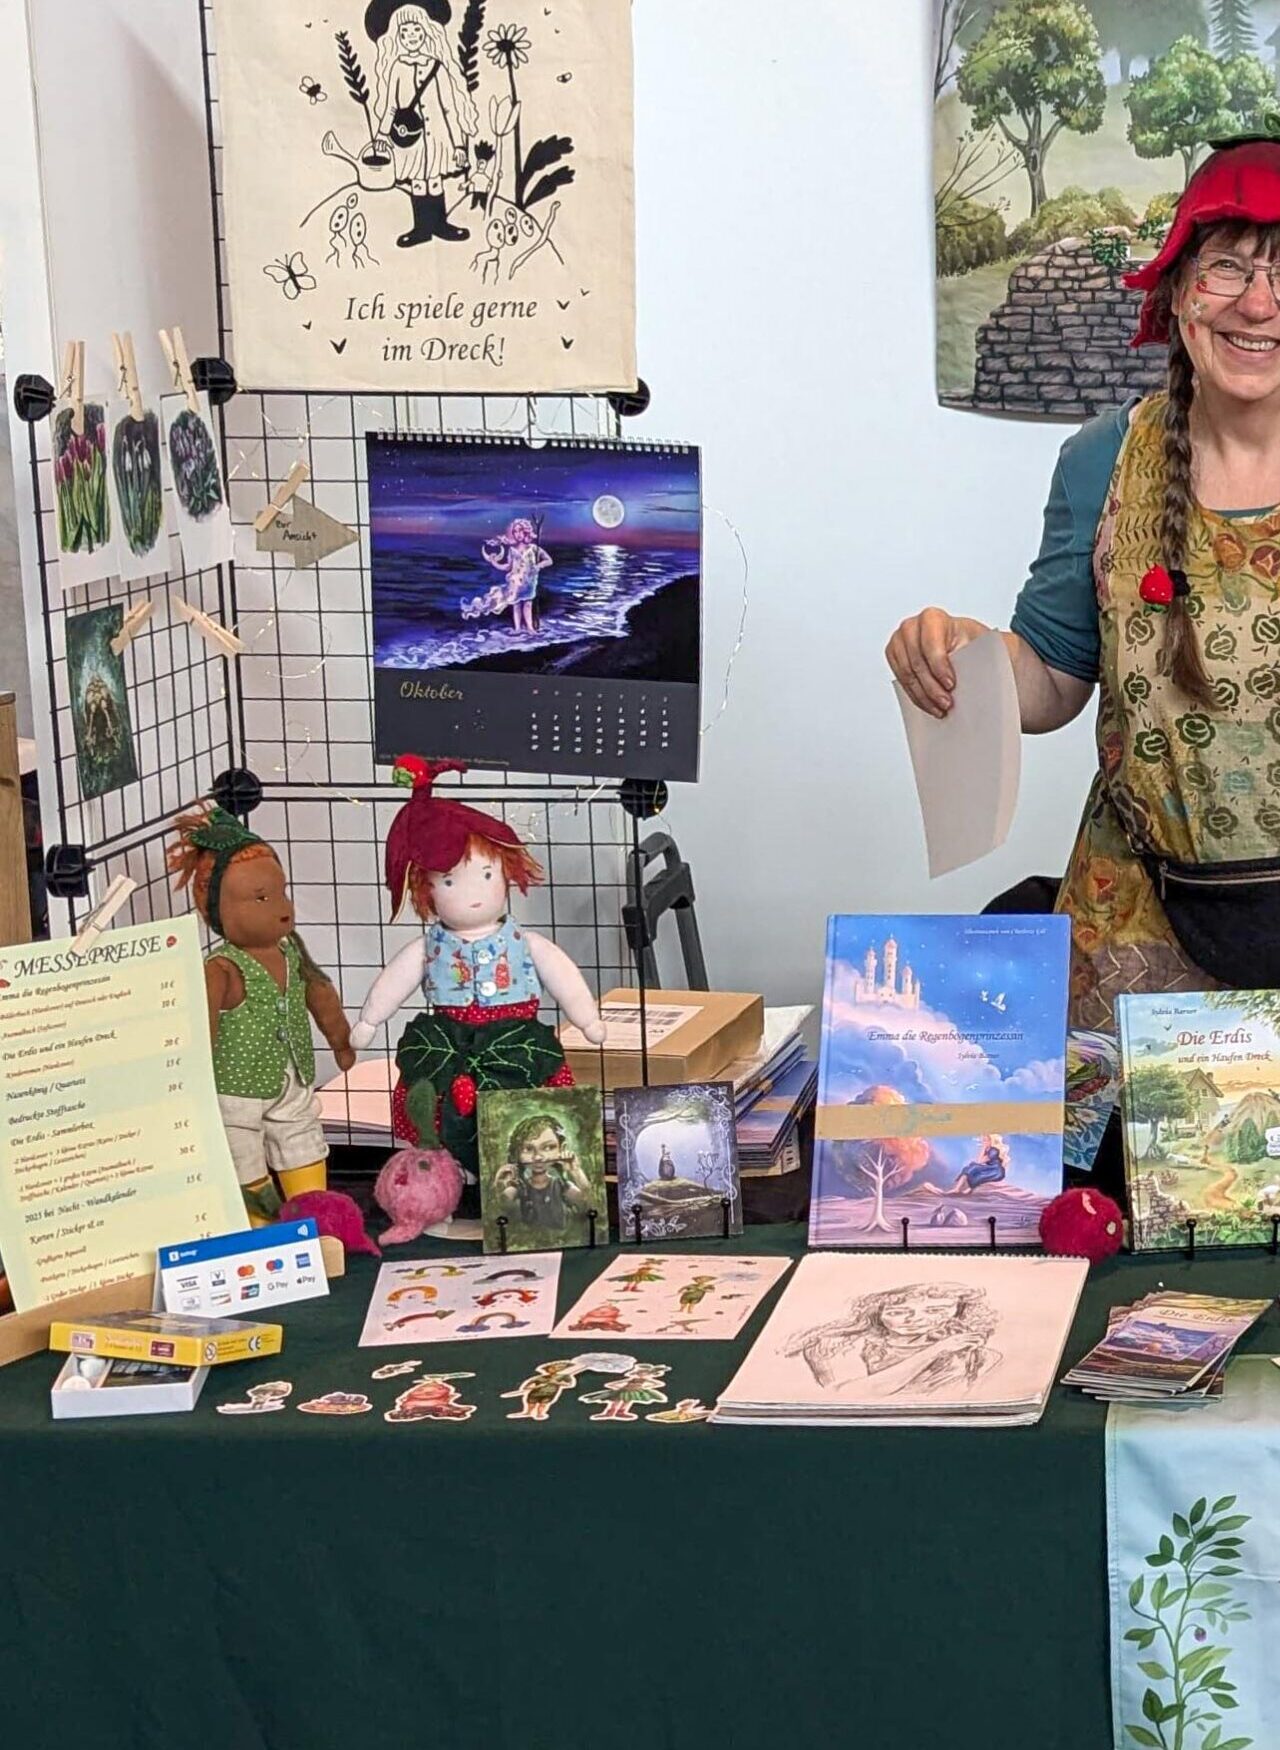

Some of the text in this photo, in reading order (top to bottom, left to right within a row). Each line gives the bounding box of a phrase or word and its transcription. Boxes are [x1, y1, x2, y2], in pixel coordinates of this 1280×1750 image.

[344, 292, 538, 328] Ich spiele gerne
[382, 333, 506, 367] im Dreck!
[400, 680, 465, 701] Oktober
[14, 935, 162, 979] MESSEPREISE
[867, 1029, 900, 1042] Emma
[902, 1029, 917, 1042] die
[1176, 1027, 1253, 1047] Die Erdis
[1178, 1051, 1274, 1064] und ein Haufen Dreck
